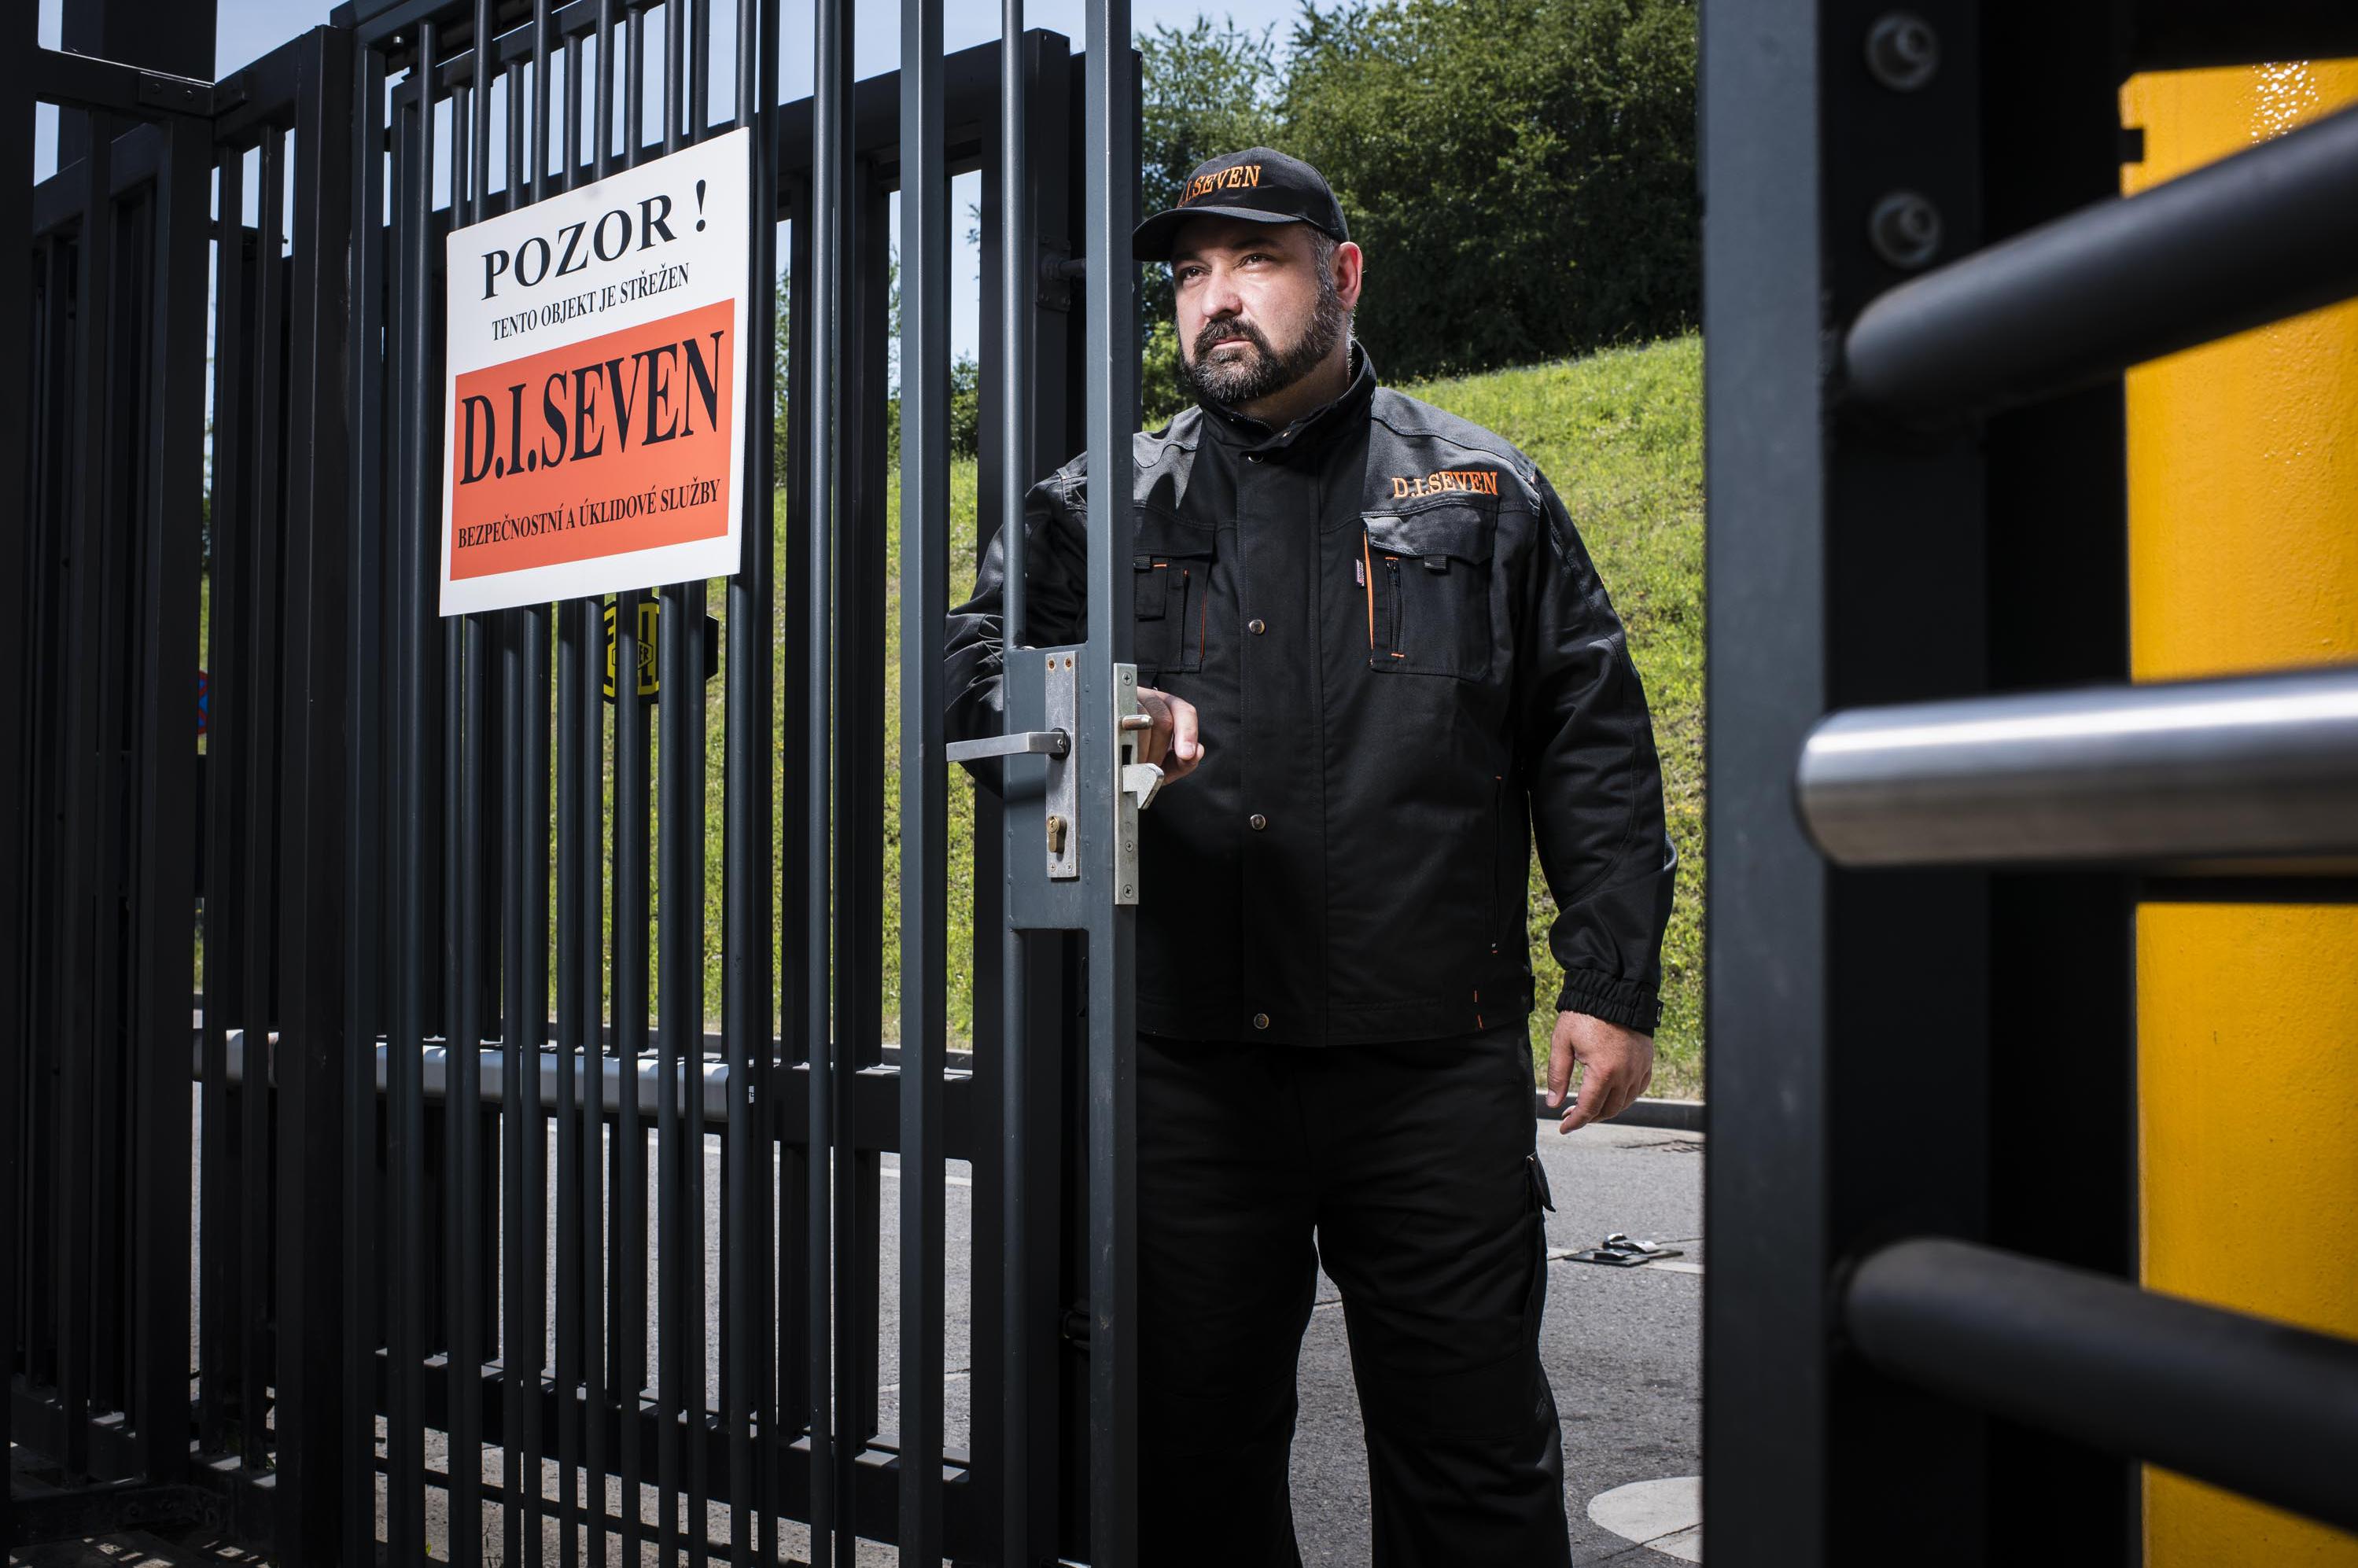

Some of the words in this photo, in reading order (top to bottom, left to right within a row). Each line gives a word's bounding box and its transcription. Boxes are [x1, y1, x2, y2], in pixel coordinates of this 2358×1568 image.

[481, 194, 677, 301] POZOR
[696, 179, 706, 233] !
[492, 309, 537, 341] TENTO
[541, 291, 596, 326] OBJEKT
[599, 285, 616, 313] JE
[620, 262, 690, 304] STŘEŽEN
[459, 330, 724, 486] D.I.SEVEN
[458, 503, 564, 549] BEZPEČNOSTNÍ
[566, 507, 576, 530] A
[579, 484, 658, 528] ÚKLIDOVÉ
[660, 476, 721, 513] SLUŽBY
[1391, 471, 1498, 499] D.I.SEVEN
